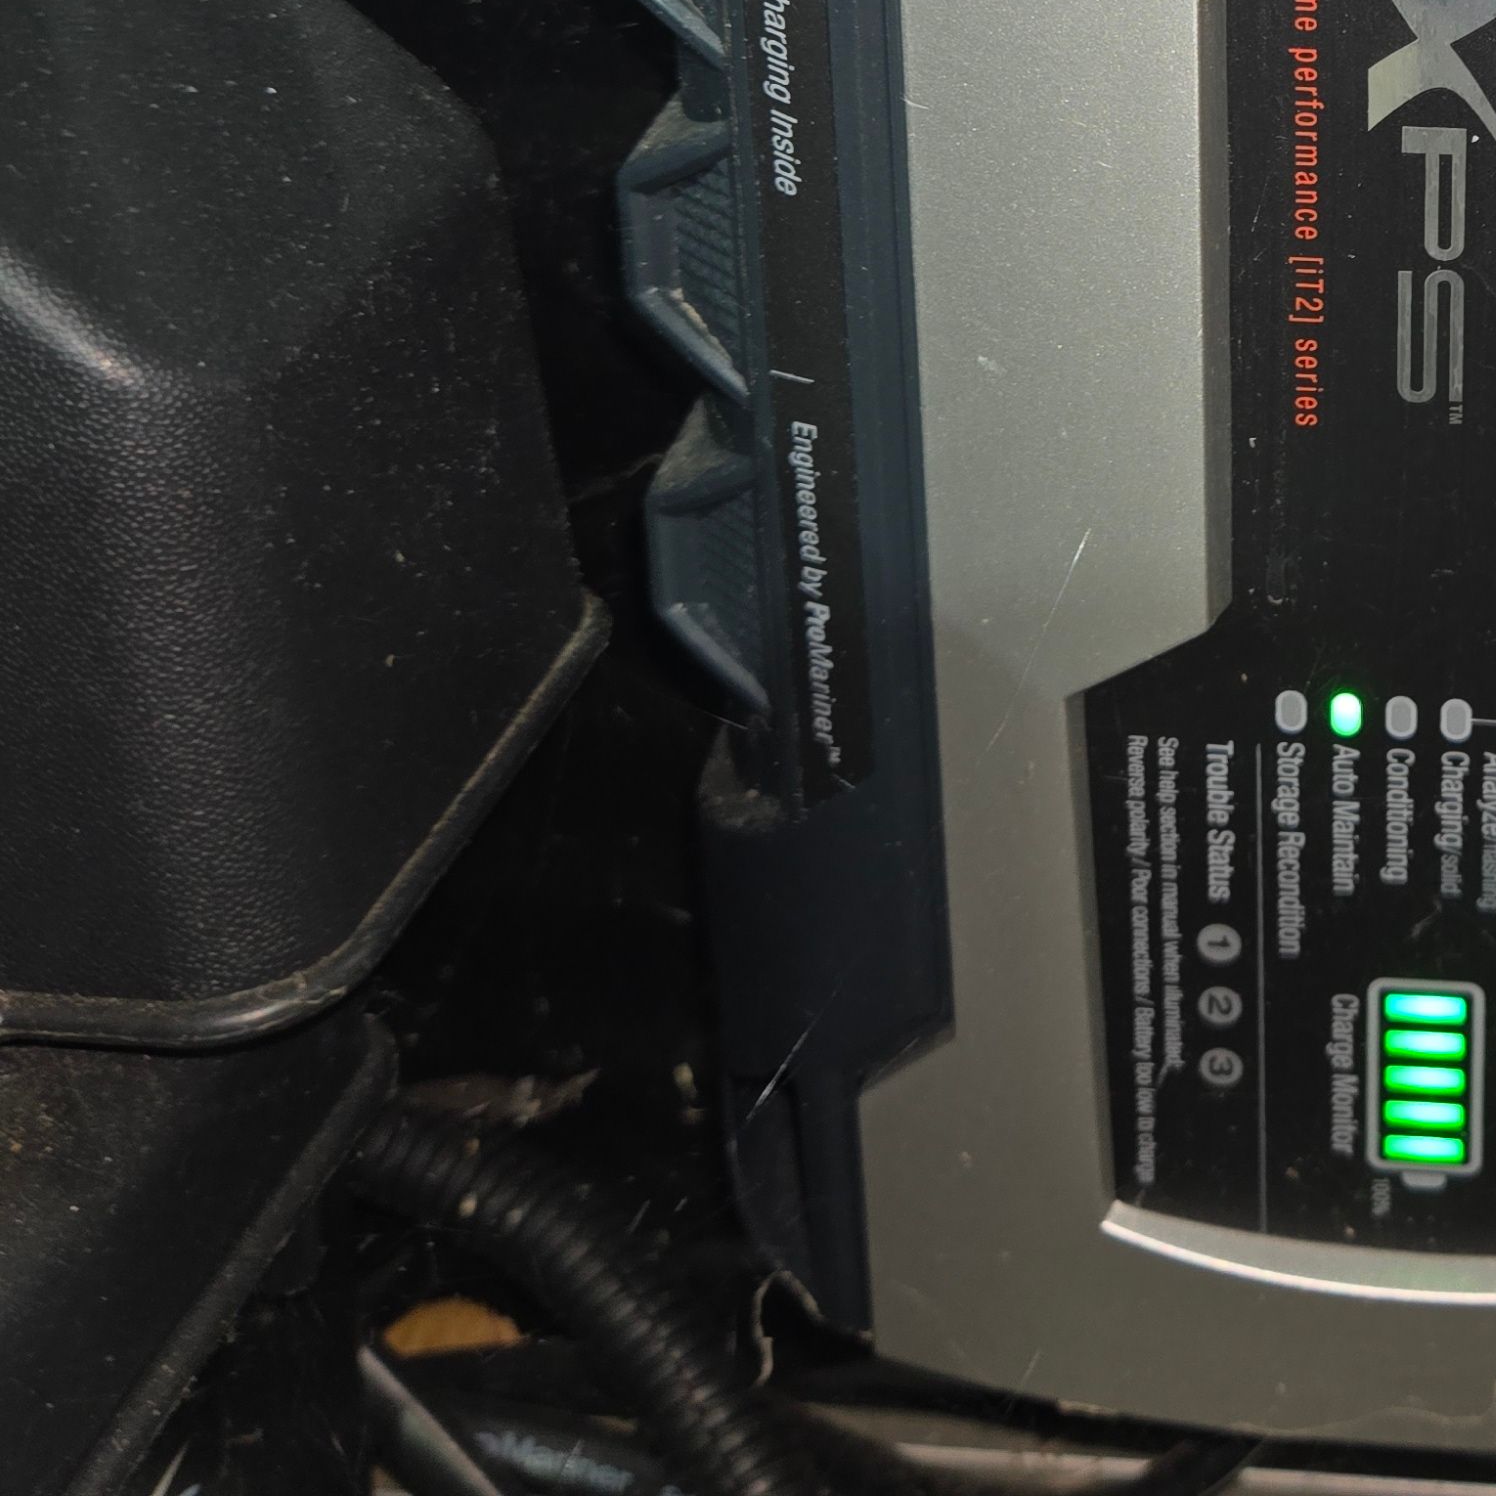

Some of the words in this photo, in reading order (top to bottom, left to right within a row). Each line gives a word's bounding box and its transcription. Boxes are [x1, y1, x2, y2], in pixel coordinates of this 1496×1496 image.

[771, 109, 802, 197] Inside
[1290, 47, 1324, 242] performance
[1293, 338, 1324, 428] series
[788, 421, 828, 561] Engineered
[795, 565, 829, 598] by
[1126, 735, 1150, 798] Reverse
[1157, 736, 1180, 767] See
[1205, 740, 1235, 824] Trouble
[1331, 744, 1360, 798] Auto
[1155, 770, 1180, 804] help
[1271, 741, 1306, 829] Storage
[1379, 748, 1415, 885] Conditioning
[1124, 800, 1150, 857] polarity
[1158, 806, 1181, 862] section
[1331, 800, 1361, 897] Maintain
[1130, 868, 1153, 904] Poor
[1160, 863, 1181, 880] in
[1206, 829, 1237, 904] Status
[1277, 830, 1308, 959] Recondition
[1160, 882, 1183, 939] manual
[1131, 906, 1155, 995] connections
[1161, 941, 1184, 985] when
[1130, 1006, 1156, 1060] Battery
[1324, 993, 1360, 1070] Charge
[1330, 1073, 1360, 1158] Monitor
[1133, 1133, 1158, 1184] charge
[1371, 1178, 1391, 1216] 100%
